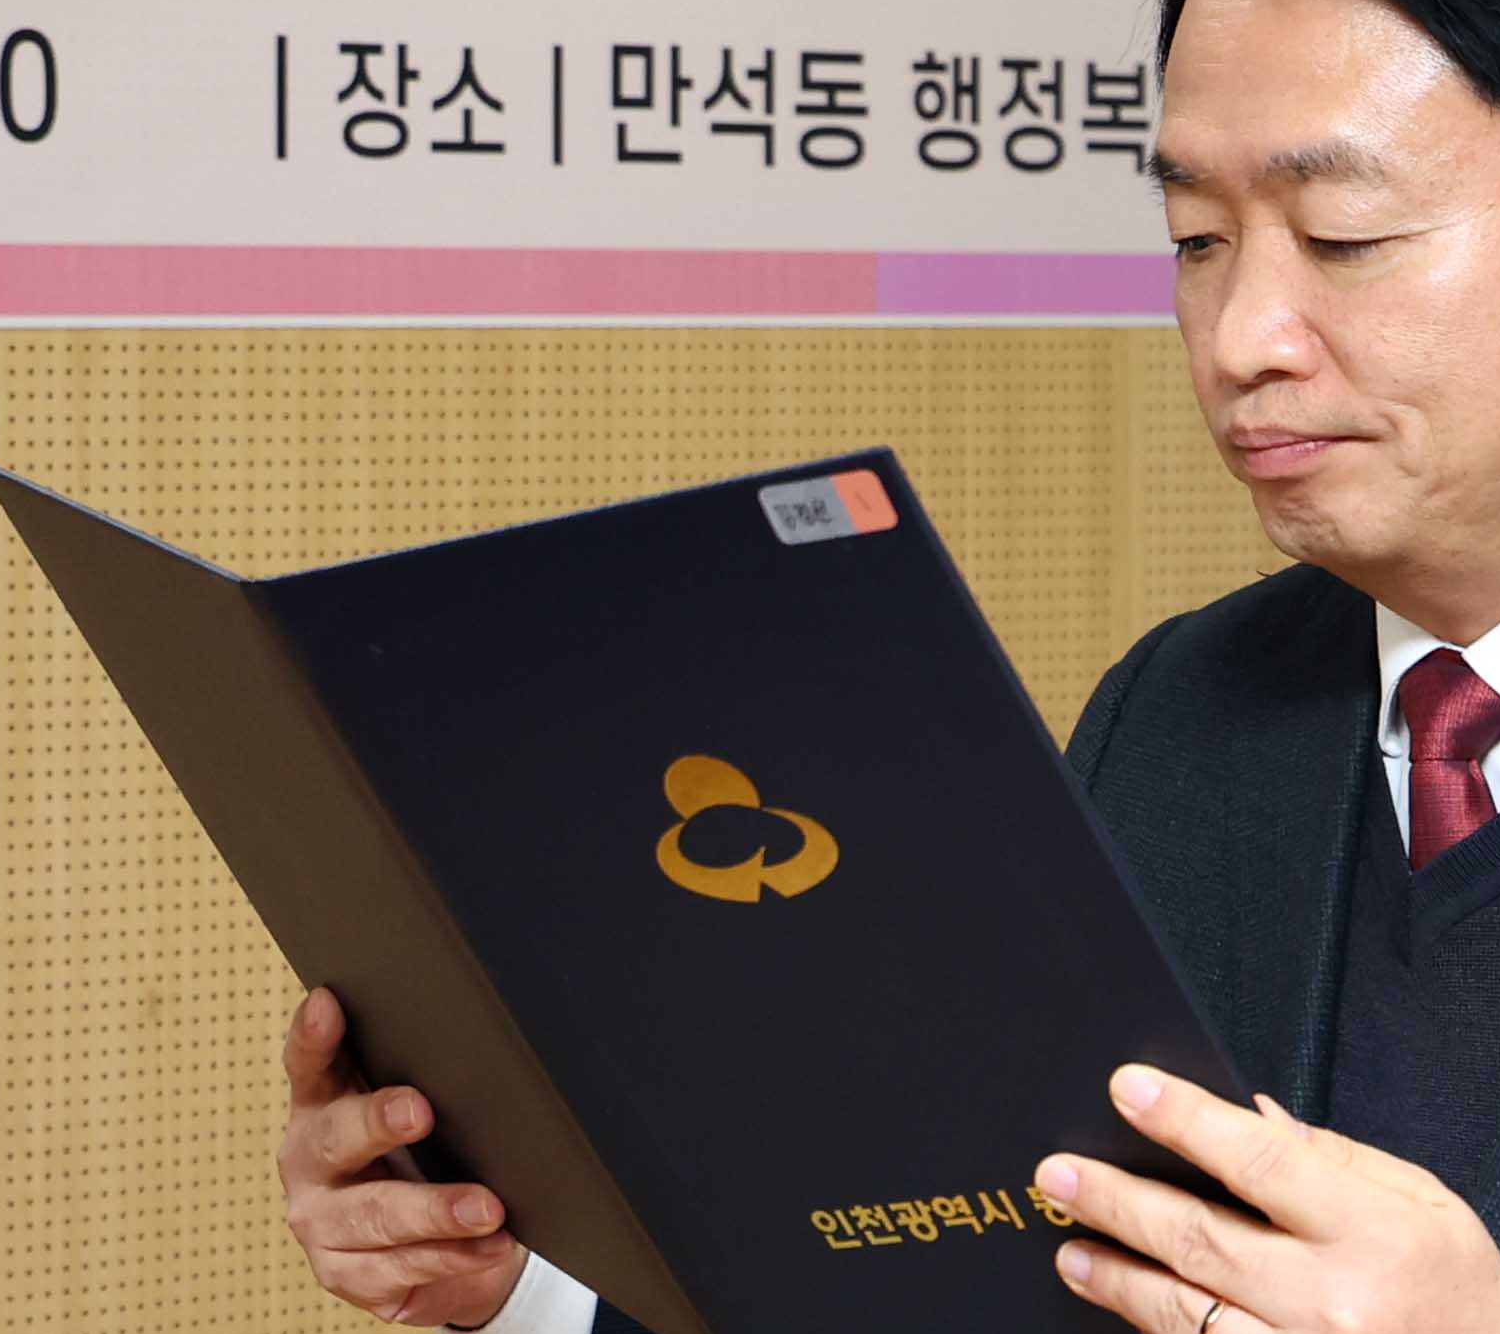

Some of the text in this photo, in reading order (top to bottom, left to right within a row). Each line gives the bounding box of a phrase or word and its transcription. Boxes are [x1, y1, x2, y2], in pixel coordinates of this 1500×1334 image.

[337, 42, 1150, 175] 장소 만석동 행정복
[810, 1189, 1026, 1250] 인천광역시
